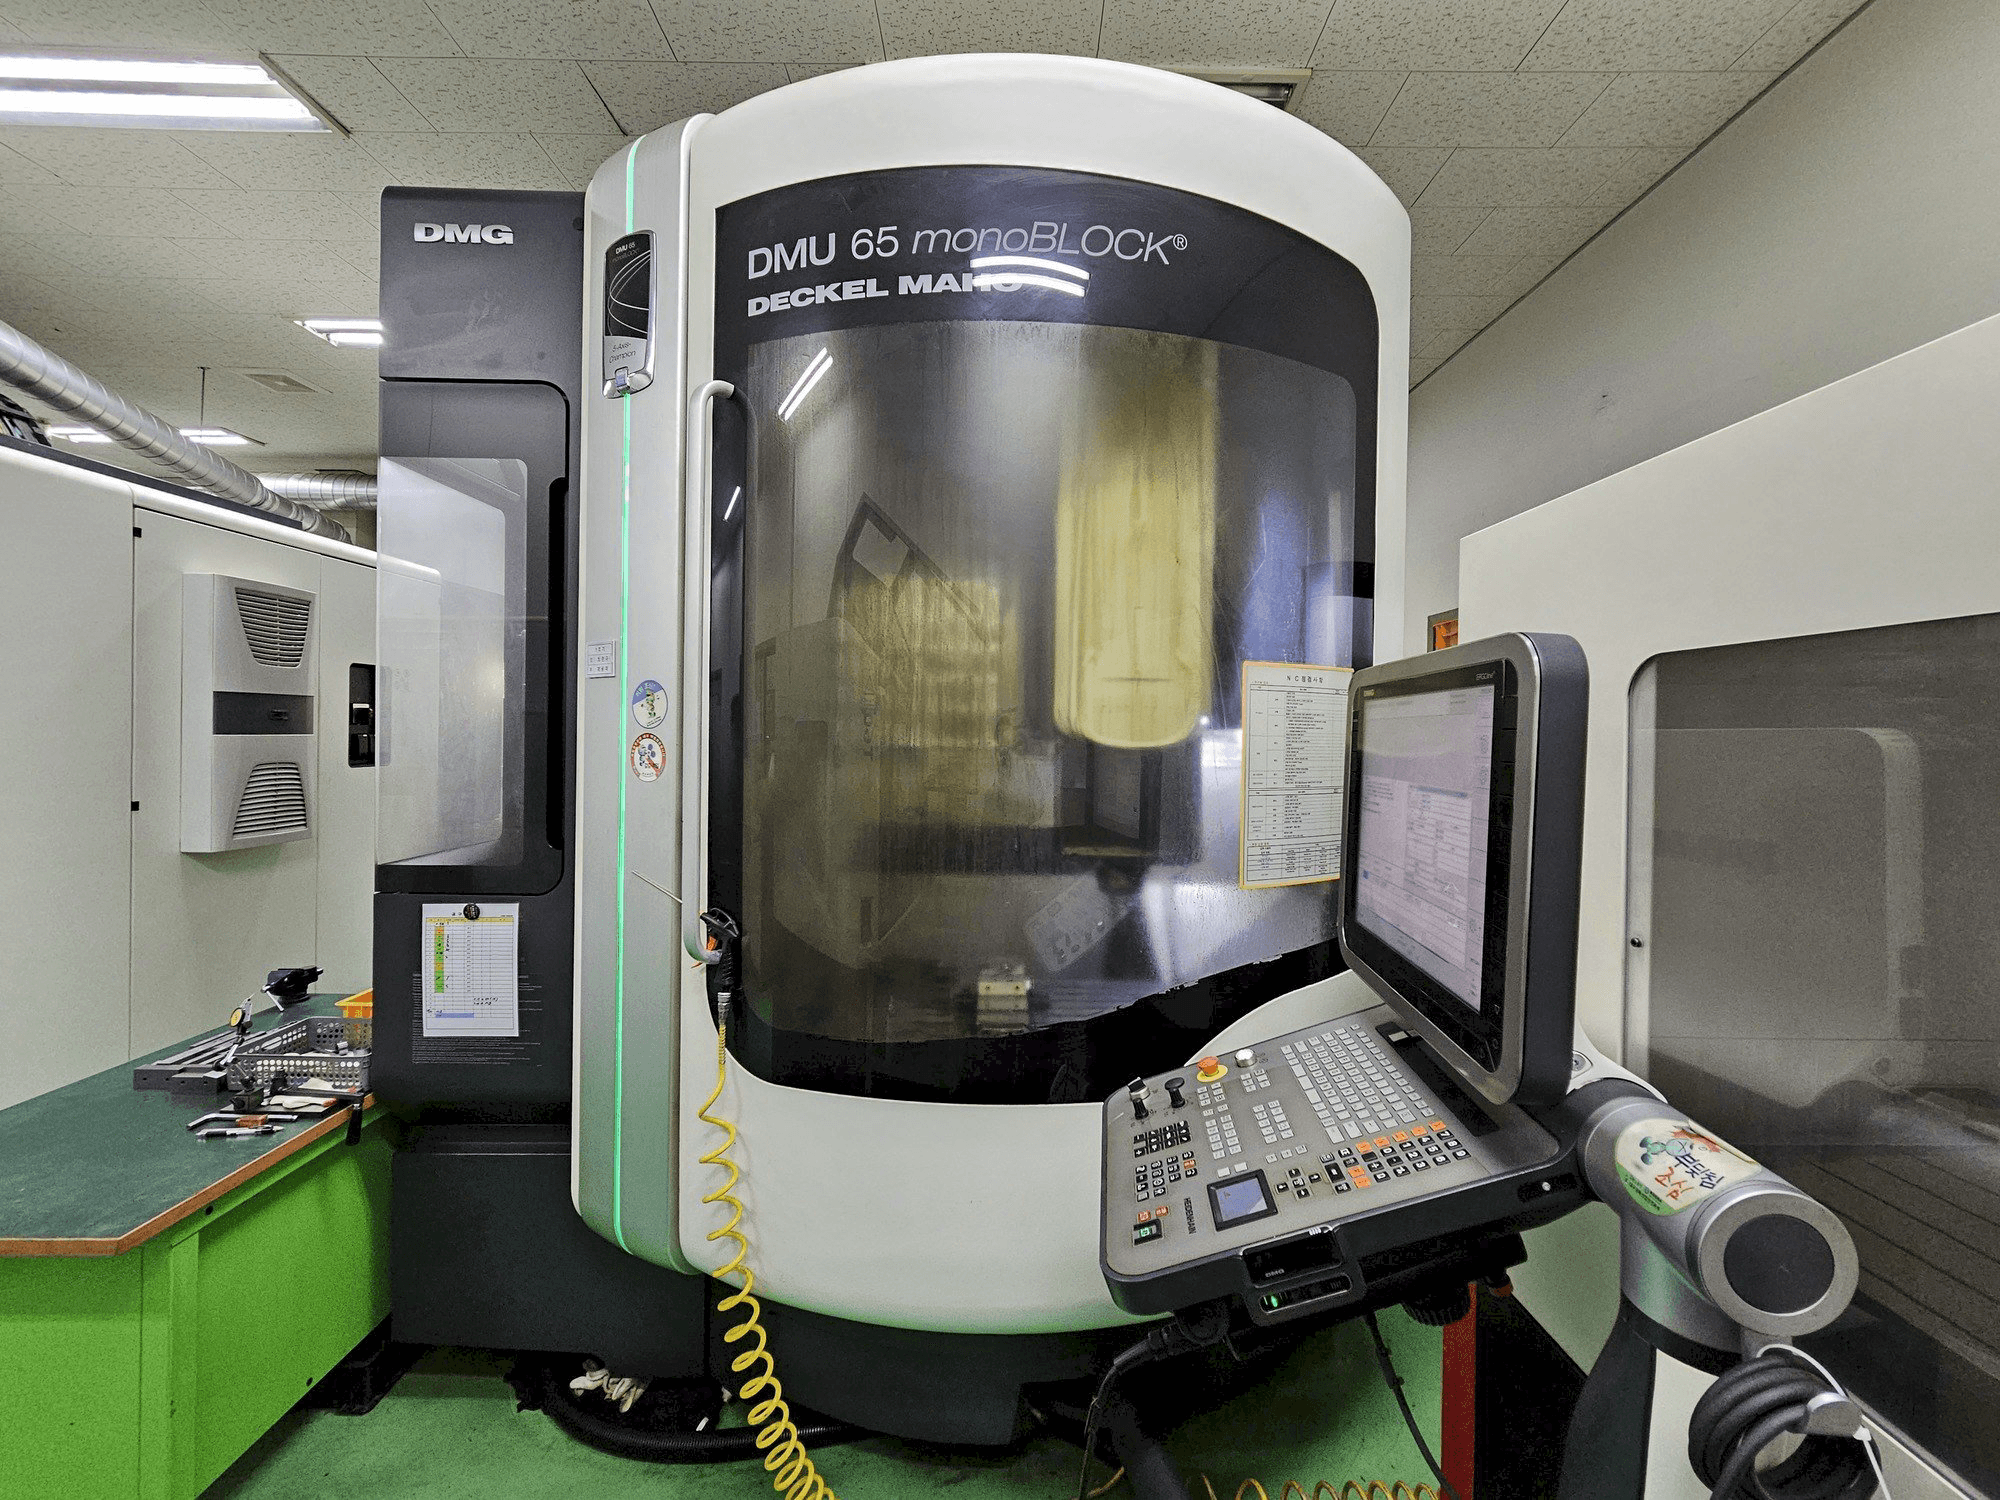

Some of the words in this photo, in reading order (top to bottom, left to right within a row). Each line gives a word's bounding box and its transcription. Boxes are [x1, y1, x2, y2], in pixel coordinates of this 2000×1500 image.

[413, 222, 514, 245] DMG
[615, 243, 628, 255] DMU
[748, 232, 836, 280] DMU
[850, 225, 899, 260] 65
[747, 277, 889, 318] DECKEL
[1654, 1166, 1695, 1200] 조심
[1674, 1152, 1725, 1190] 부딪침
[1264, 1268, 1285, 1278] DMG
